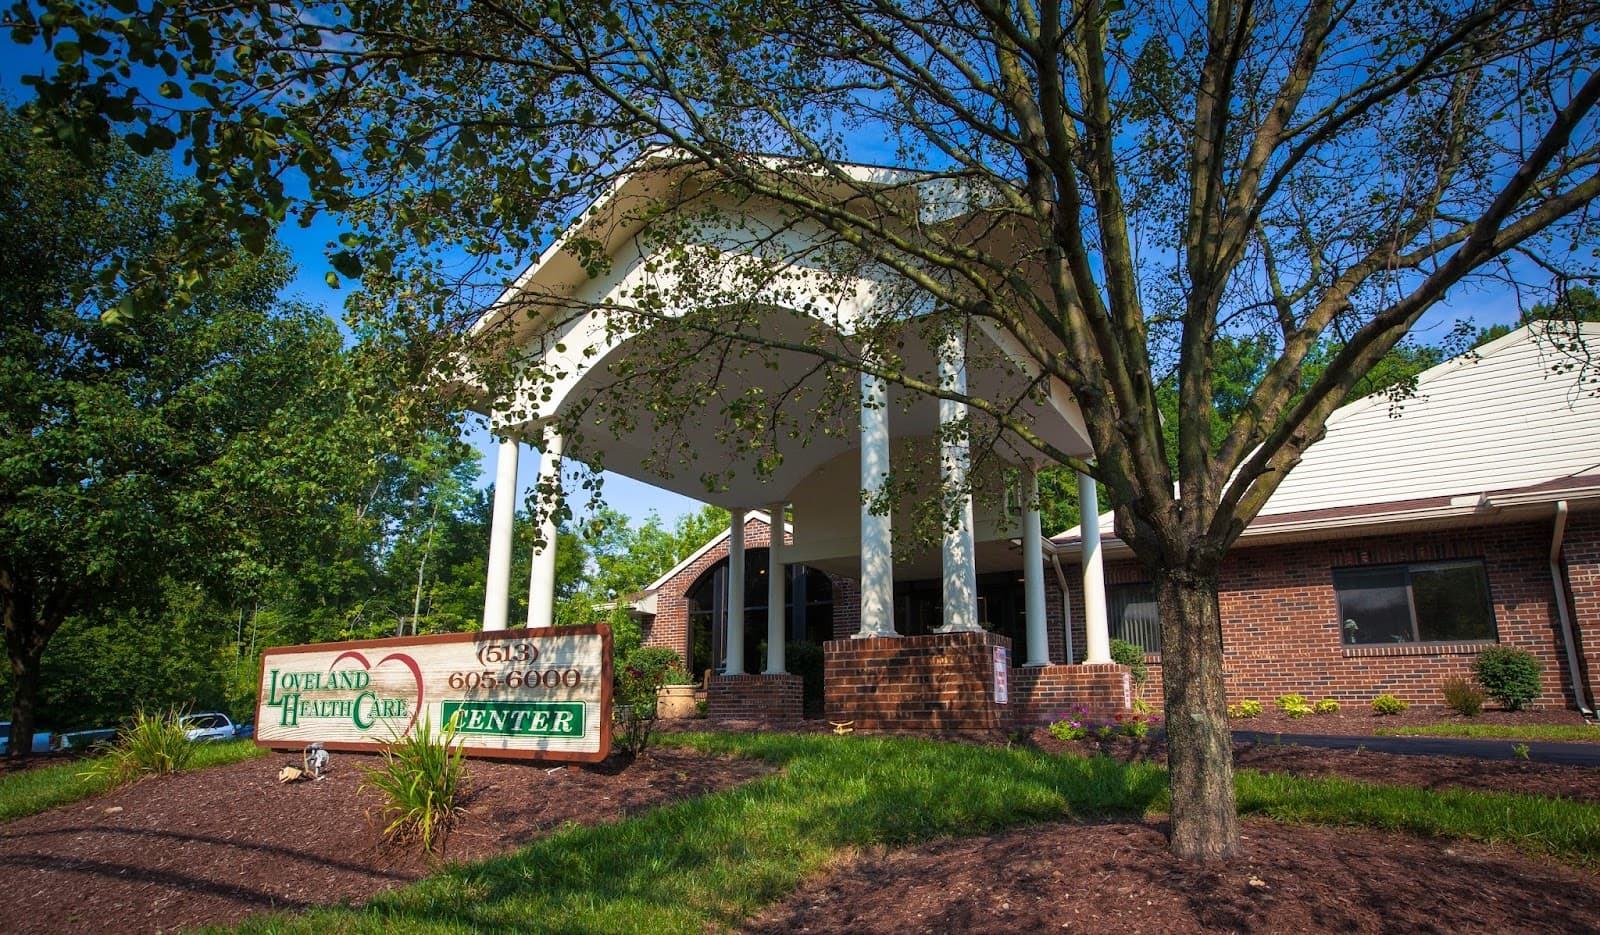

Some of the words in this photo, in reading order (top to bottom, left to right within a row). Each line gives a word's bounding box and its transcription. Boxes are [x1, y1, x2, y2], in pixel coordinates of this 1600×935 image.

[478, 643, 539, 667] (513)
[267, 668, 370, 707] LOVELAND
[448, 668, 581, 690] 605-6000
[455, 708, 574, 733] CENTER
